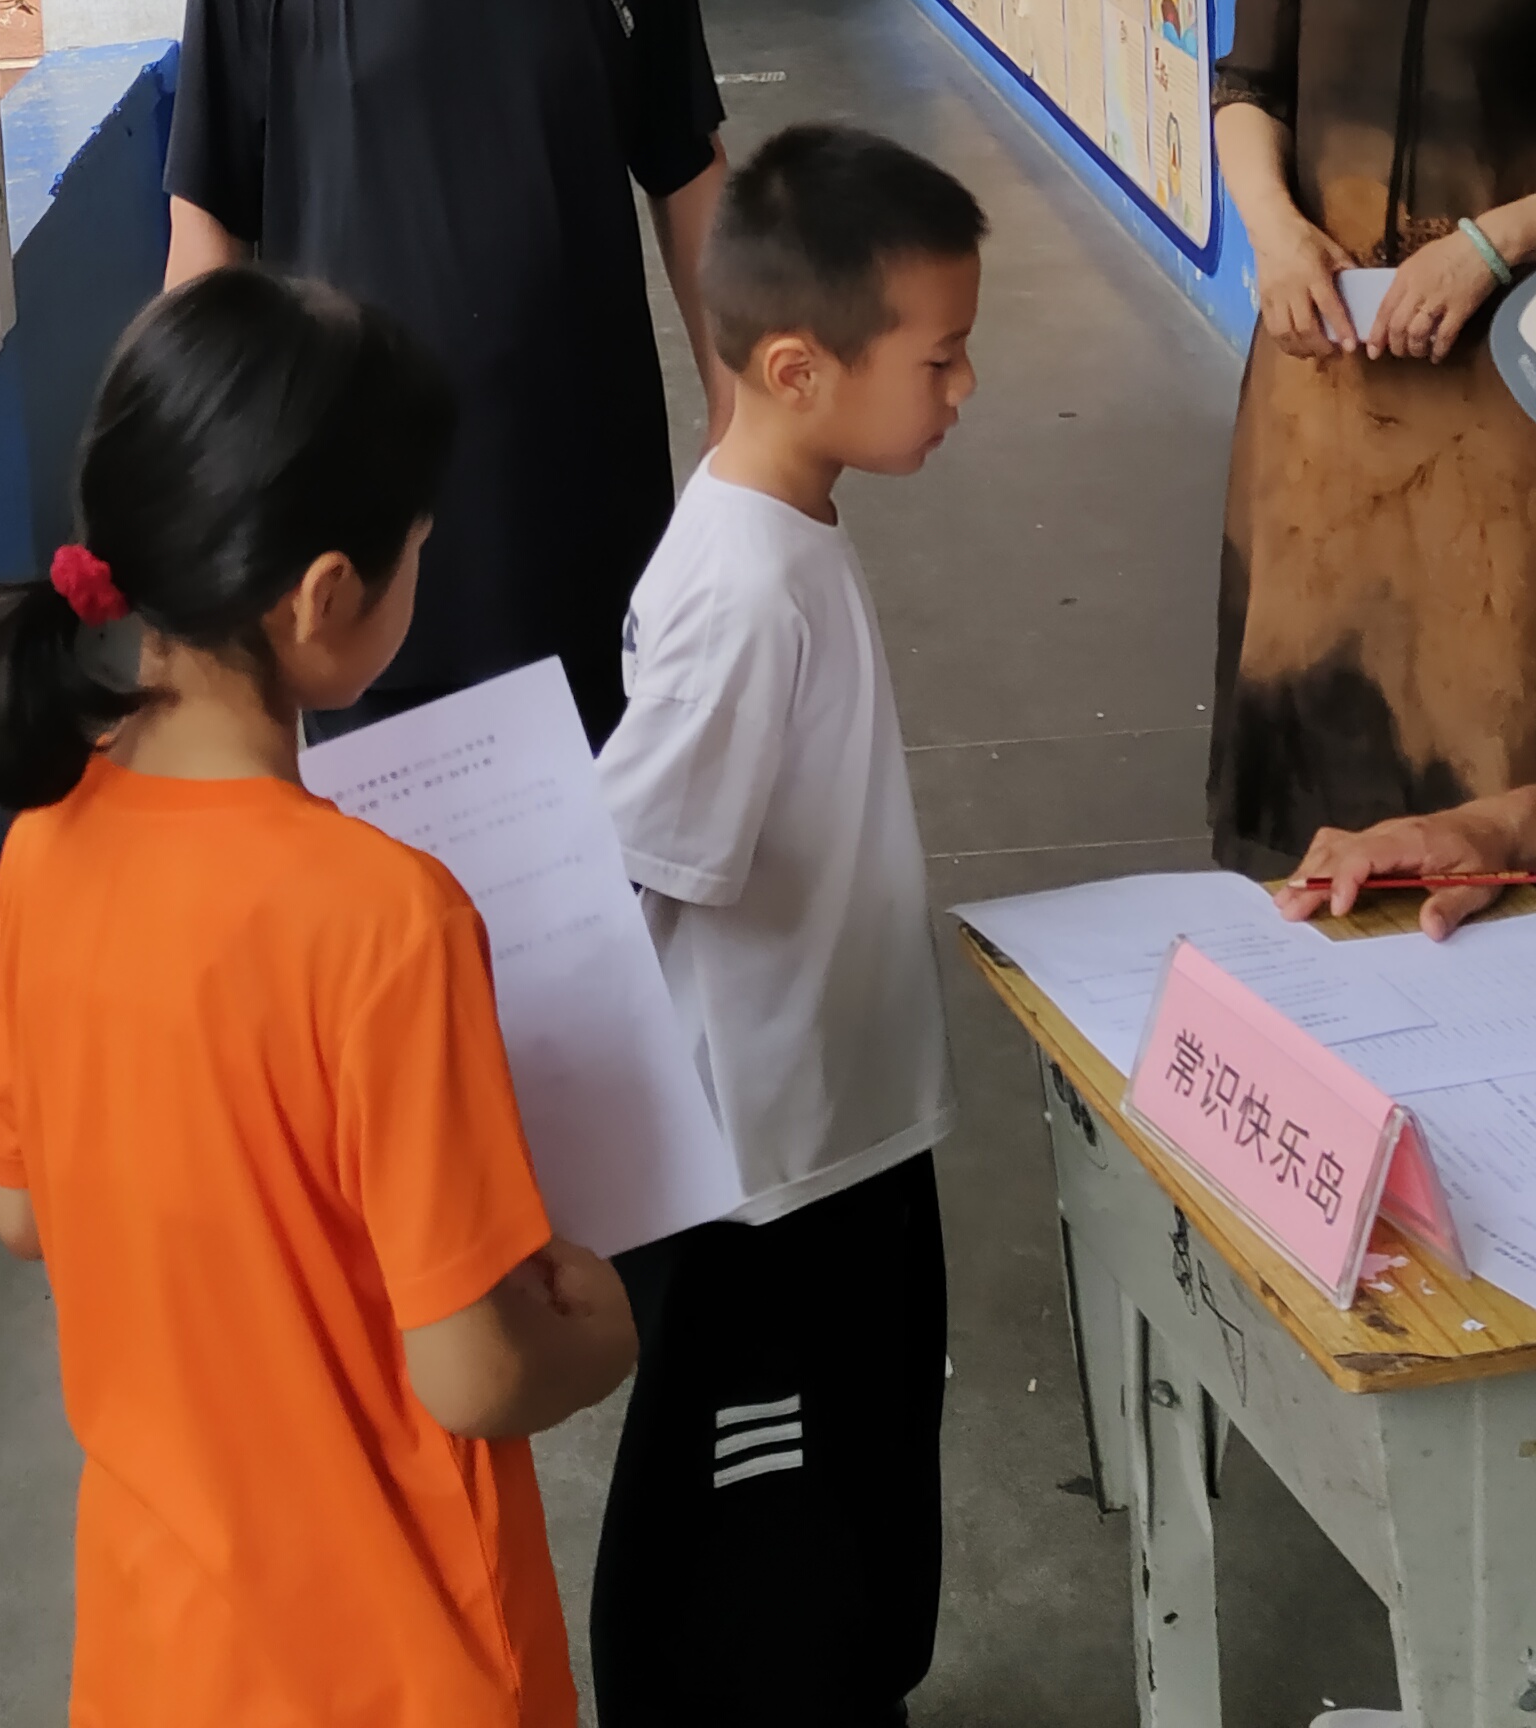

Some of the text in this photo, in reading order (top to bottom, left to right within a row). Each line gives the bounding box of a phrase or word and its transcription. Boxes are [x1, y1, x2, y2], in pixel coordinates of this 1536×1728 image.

[1165, 1029, 1345, 1226] 常识快乐岛
